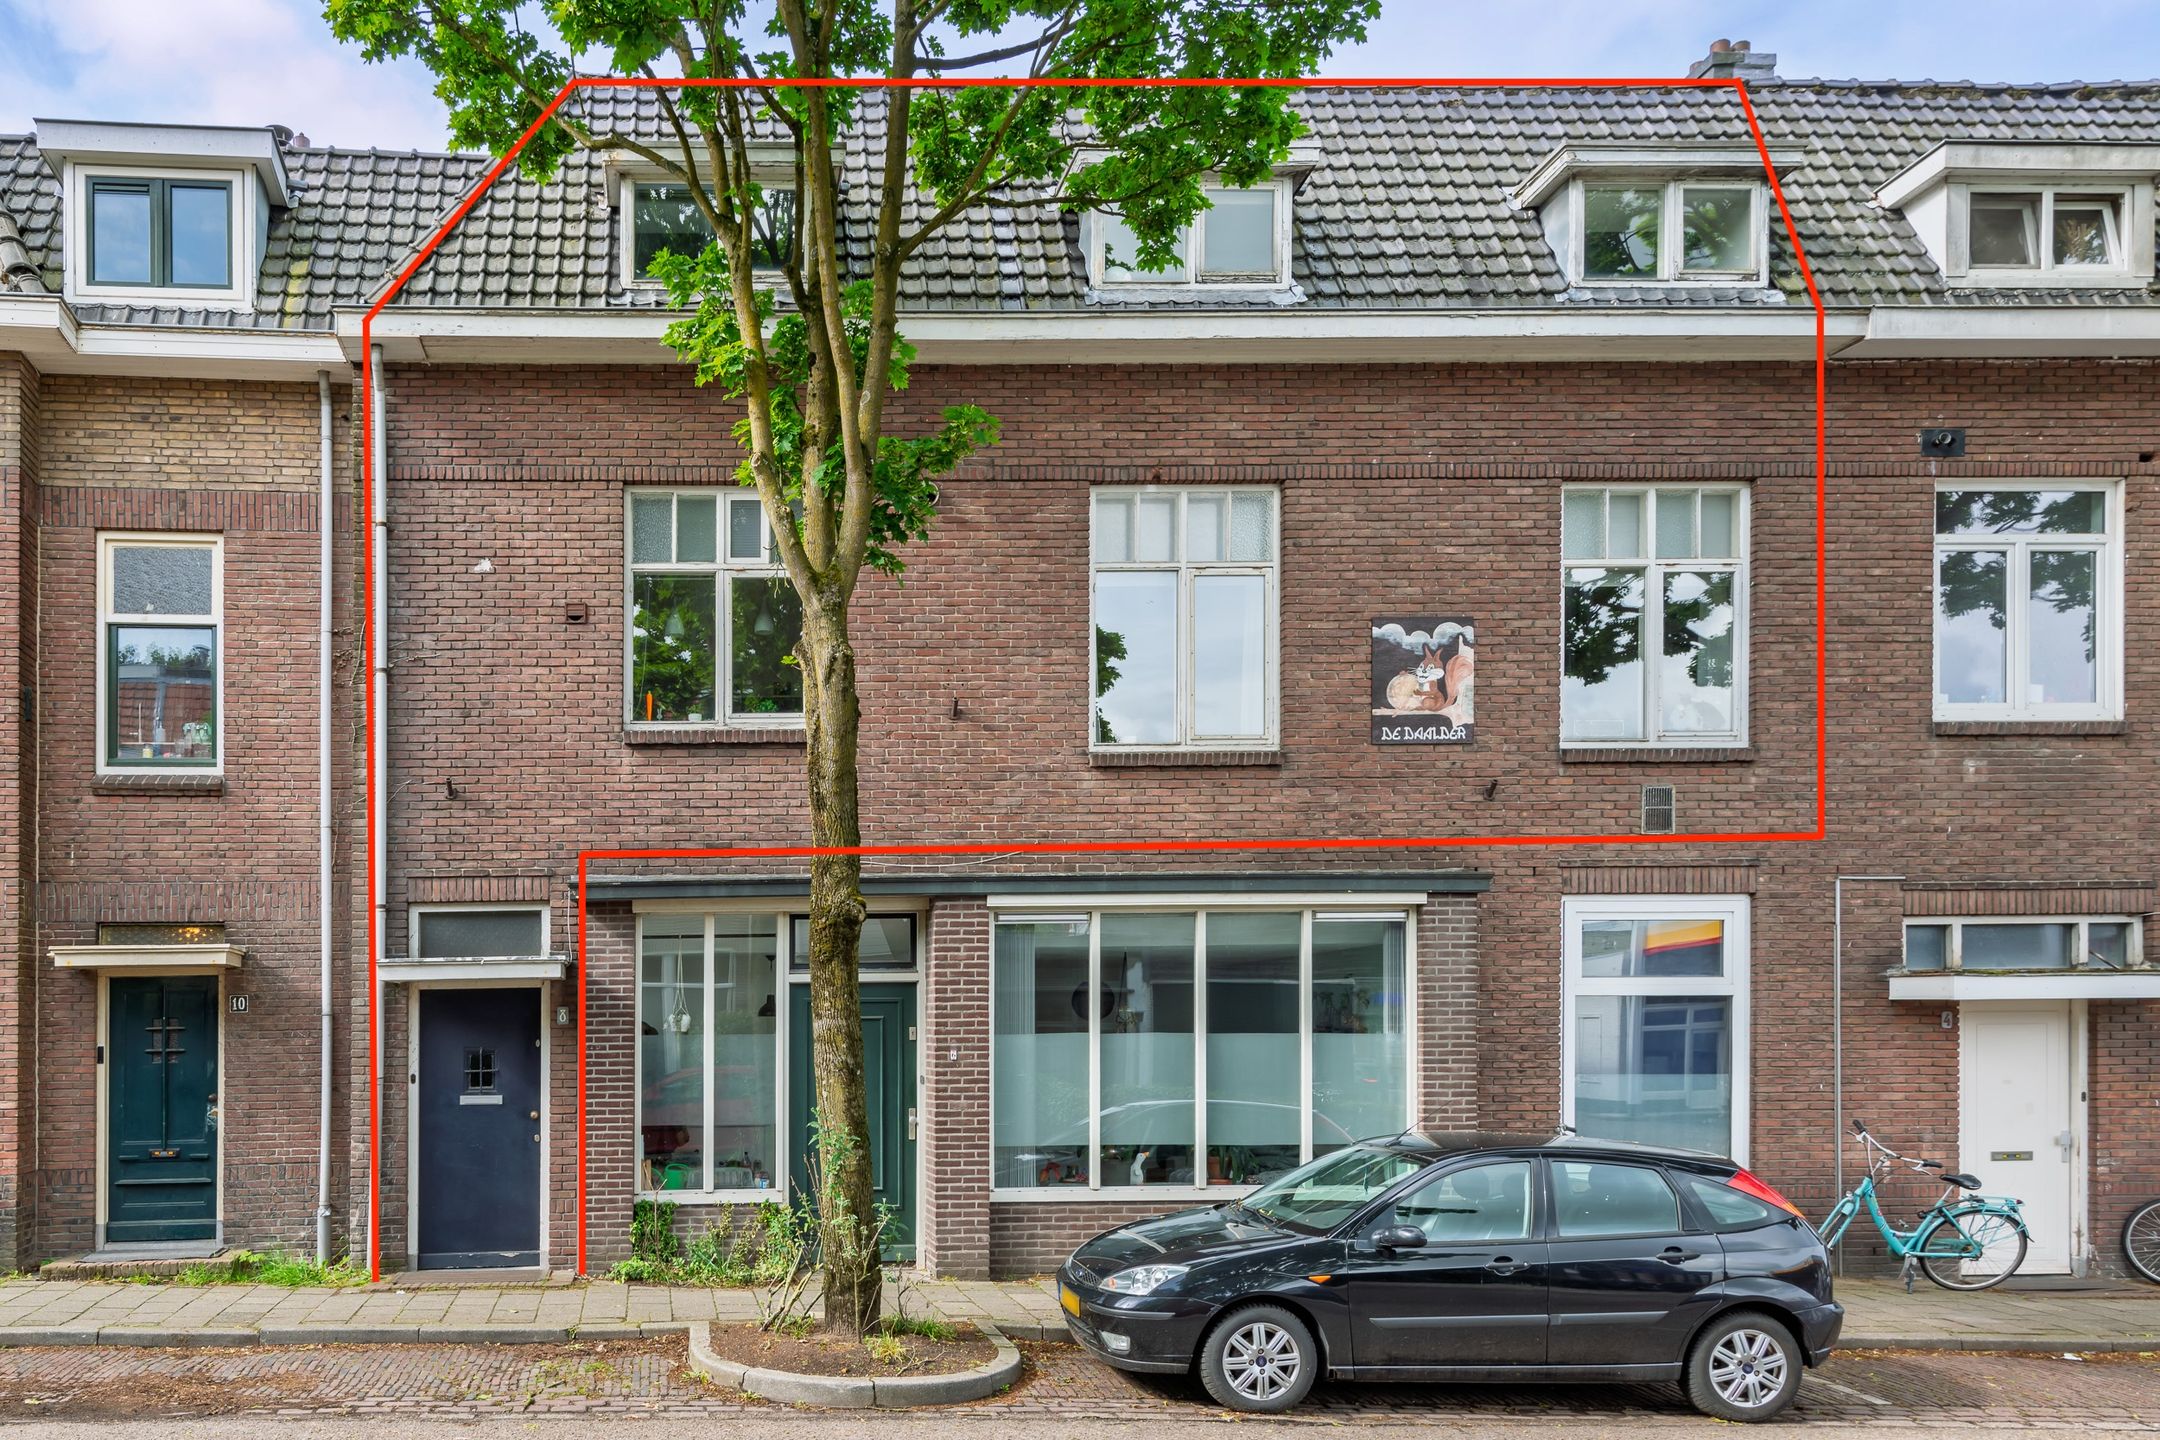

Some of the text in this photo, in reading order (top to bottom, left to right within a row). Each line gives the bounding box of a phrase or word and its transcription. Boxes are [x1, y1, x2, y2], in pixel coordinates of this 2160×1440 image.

[1381, 726, 1466, 740] DE DAALDER
[232, 997, 246, 1010] 10
[559, 1009, 567, 1022] 8
[1943, 1013, 1951, 1026] 4
